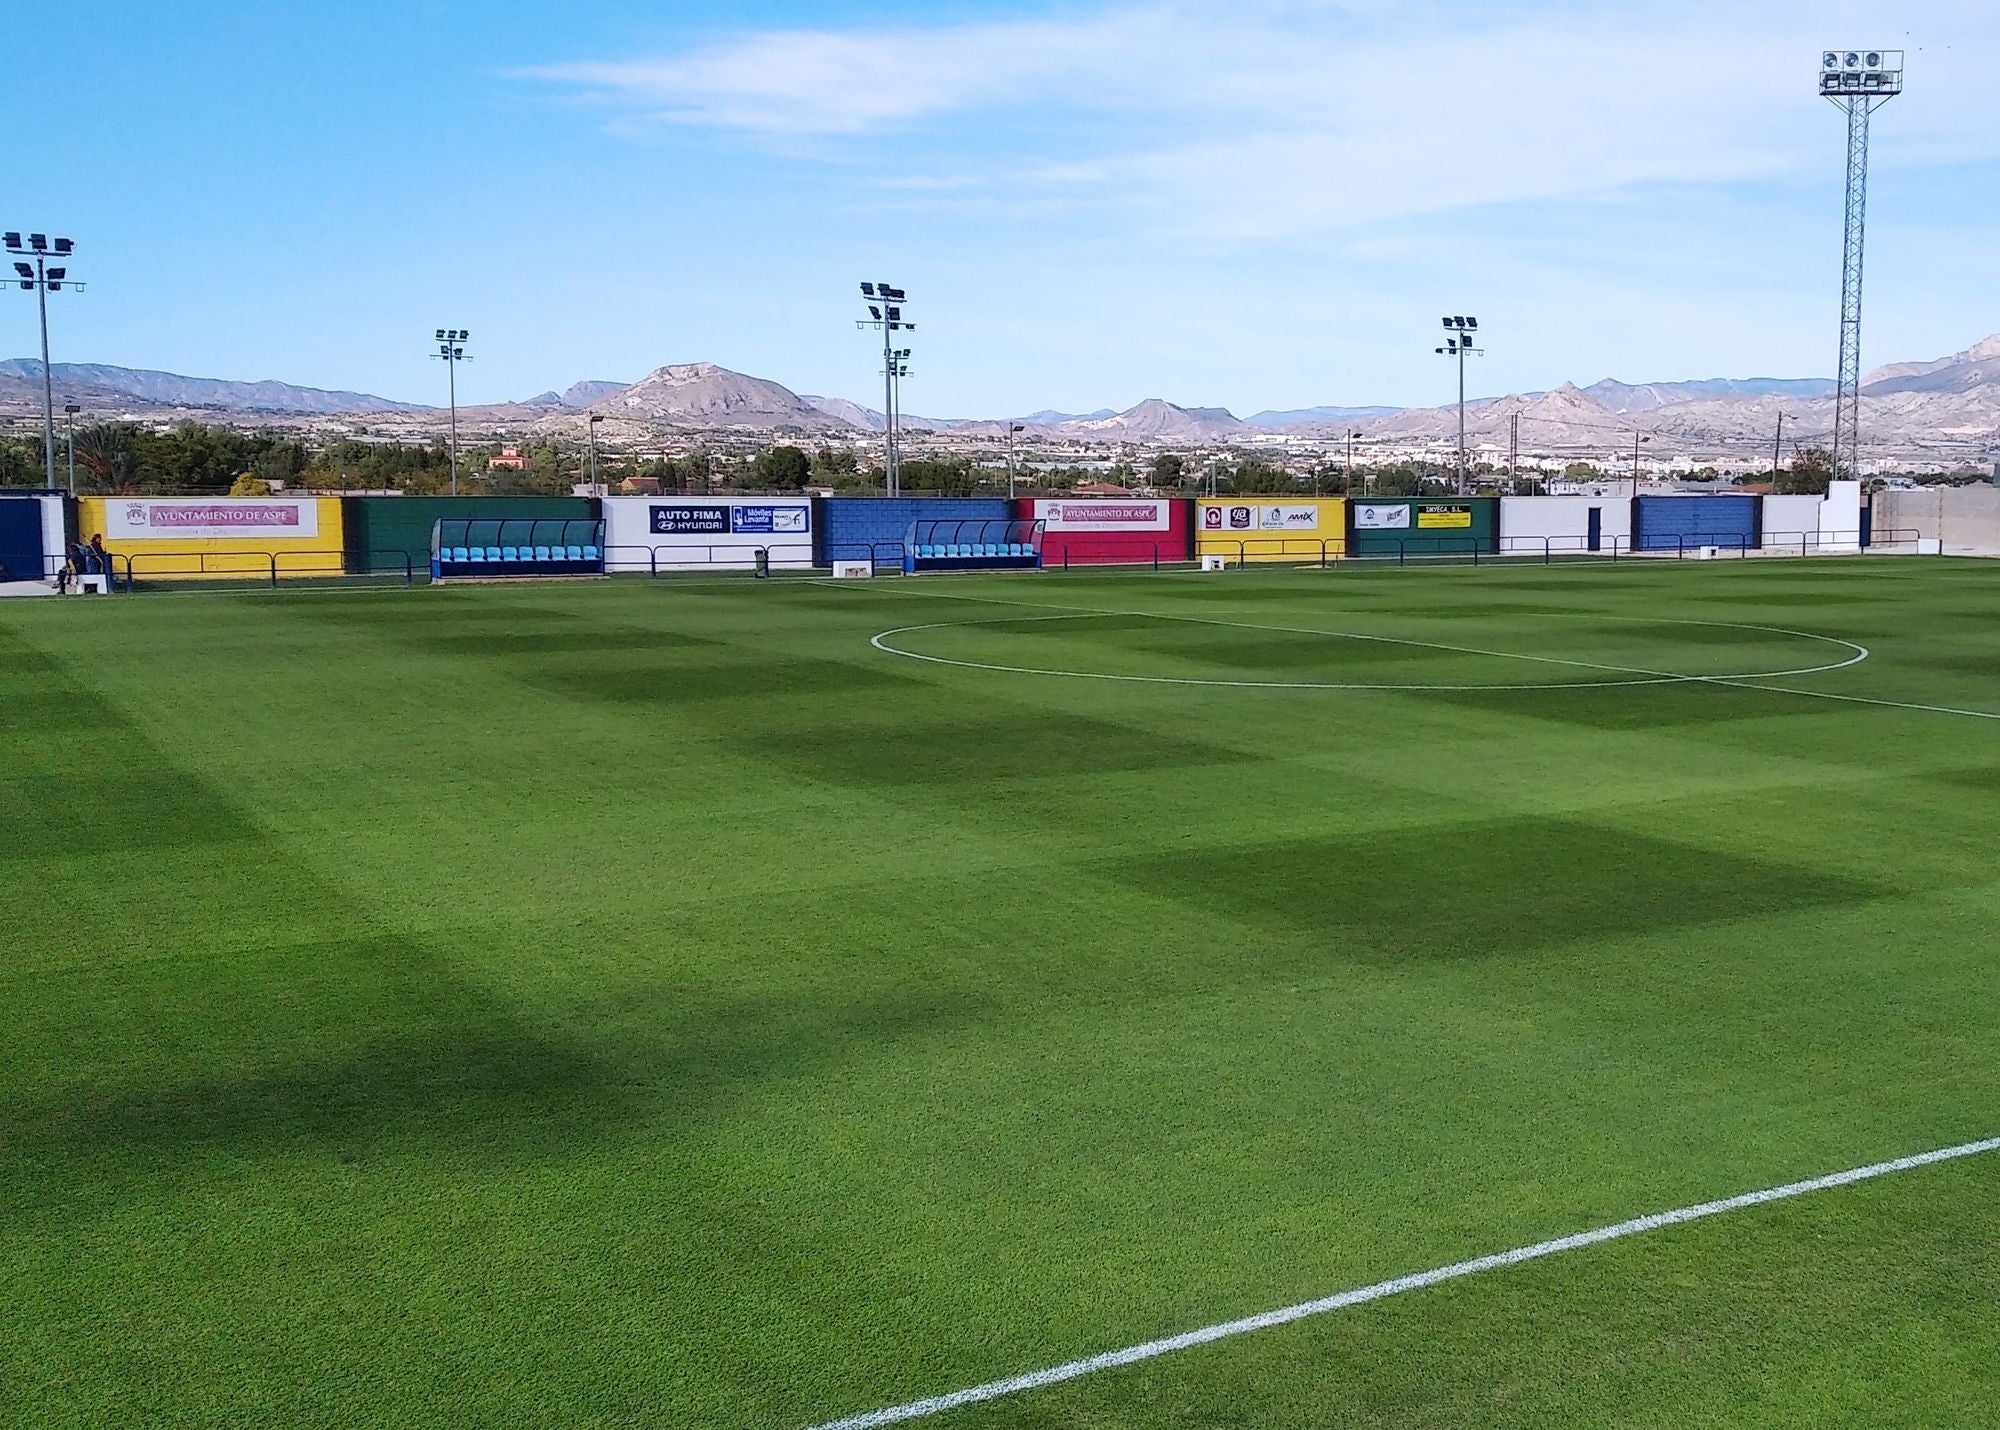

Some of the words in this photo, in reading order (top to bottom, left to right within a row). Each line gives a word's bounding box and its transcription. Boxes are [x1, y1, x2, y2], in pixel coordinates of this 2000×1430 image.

[156, 511, 243, 521] AYUNTAMIENTO
[245, 511, 260, 520] DE
[262, 511, 288, 520] ASPE
[657, 510, 691, 520] AUTO
[692, 510, 723, 520] FIMA
[1065, 509, 1121, 518] AYUNTAMIENTO
[1122, 509, 1133, 517] DE
[1133, 509, 1150, 517] ASPE
[677, 521, 723, 529] HYUNDAI
